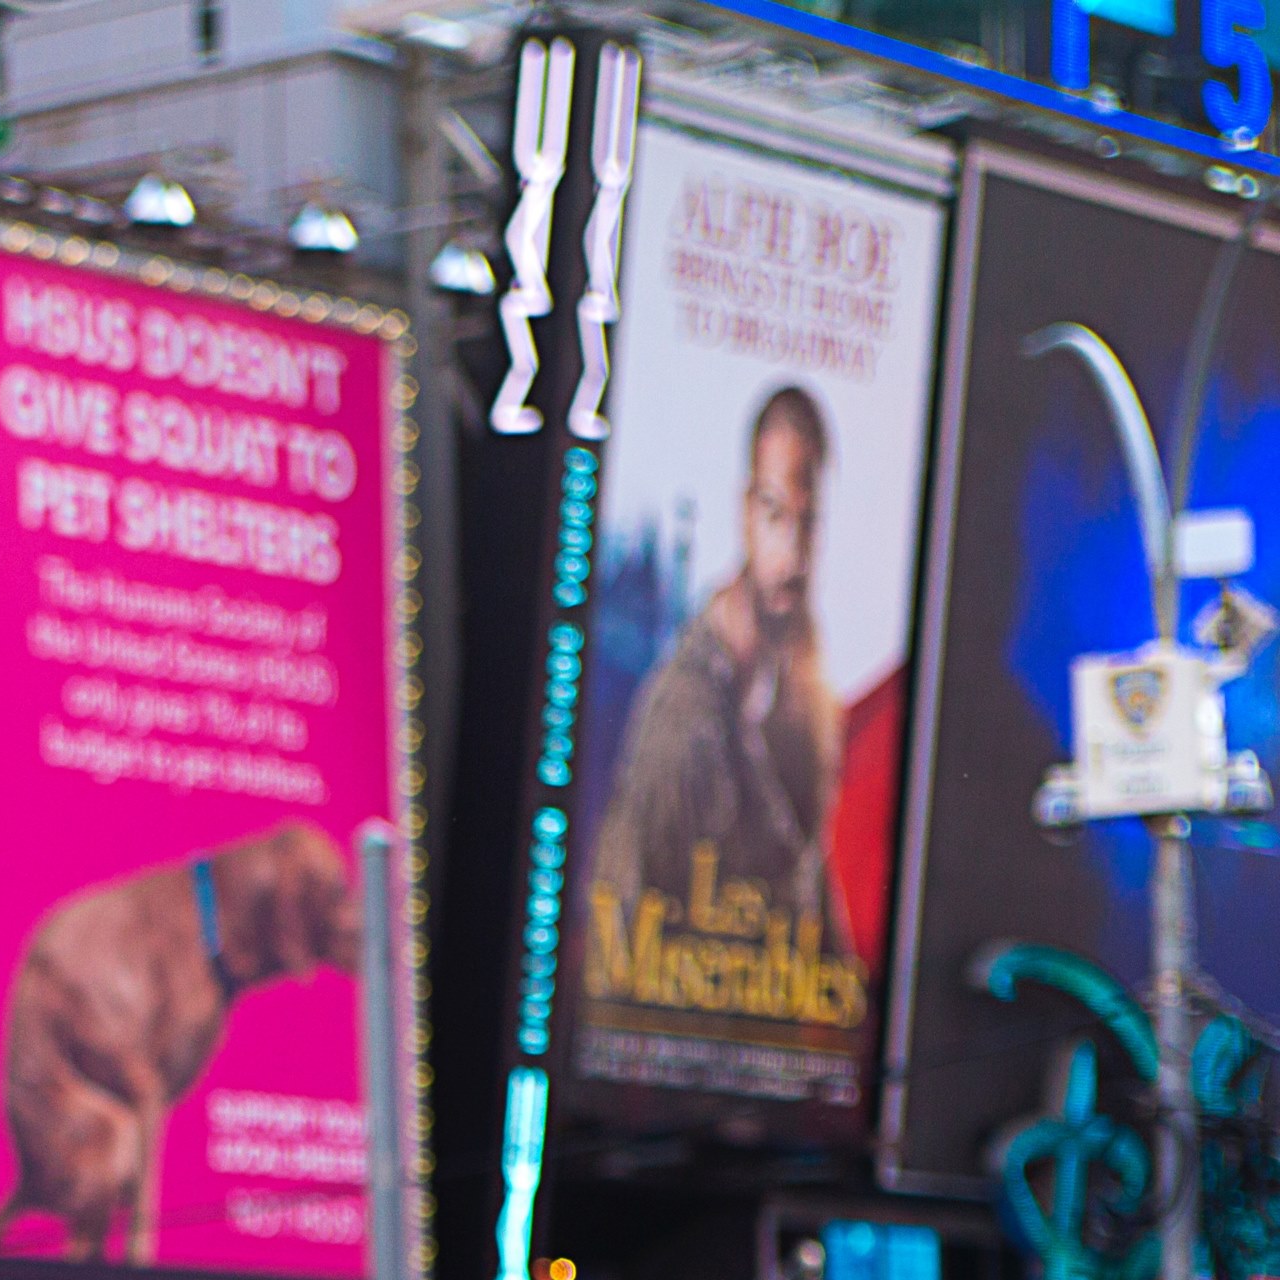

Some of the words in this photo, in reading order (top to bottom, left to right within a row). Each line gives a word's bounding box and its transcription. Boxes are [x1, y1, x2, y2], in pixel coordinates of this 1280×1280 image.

[285, 424, 358, 502] TO
[16, 457, 114, 542] PET
[113, 477, 341, 585] SHELTERS
